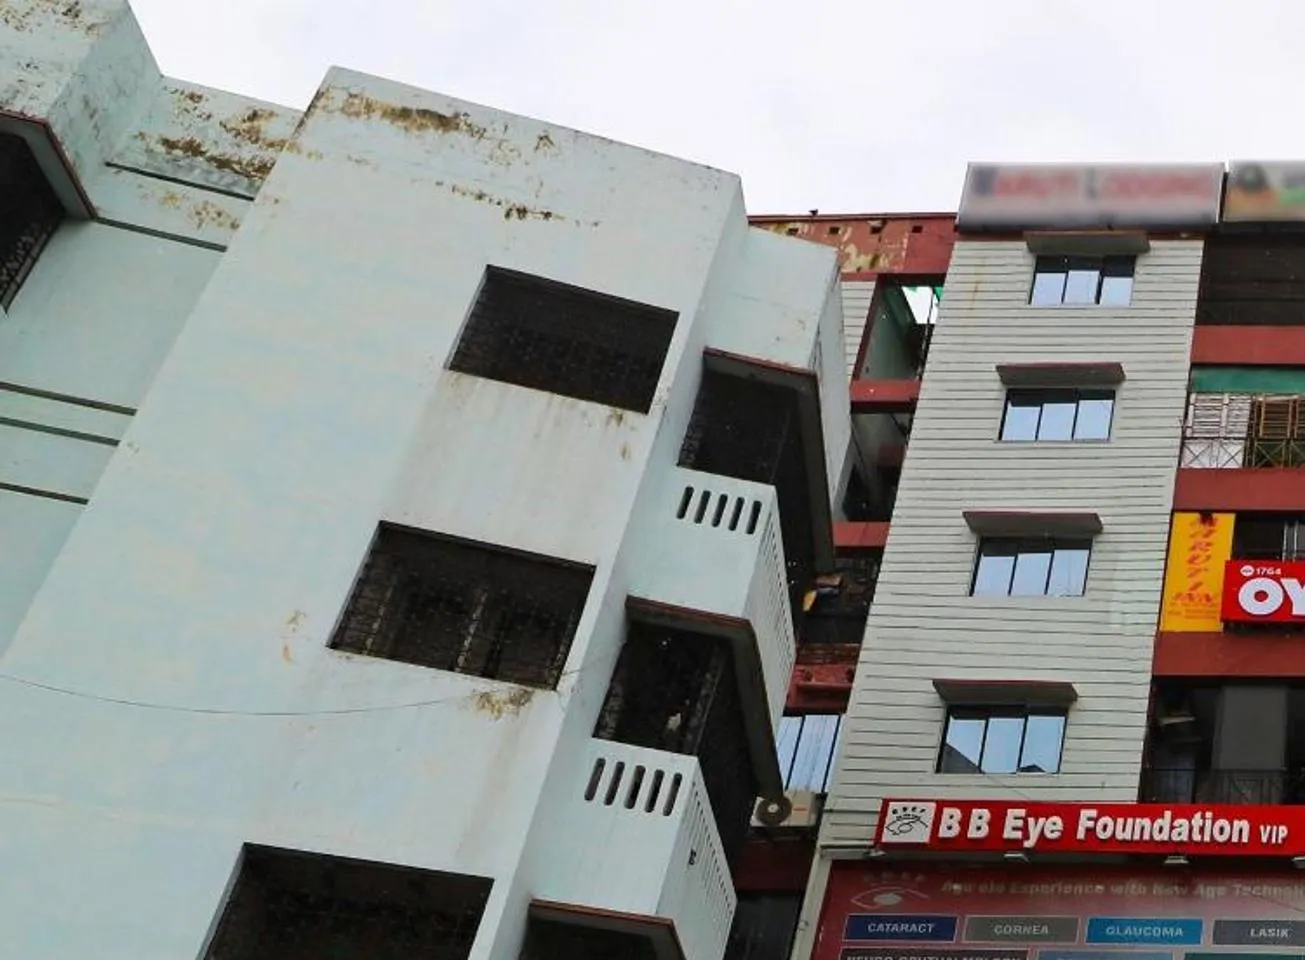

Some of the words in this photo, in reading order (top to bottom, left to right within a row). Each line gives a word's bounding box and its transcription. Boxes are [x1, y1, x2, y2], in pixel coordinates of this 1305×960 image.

[1256, 567, 1281, 575] 1764
[938, 807, 962, 839] B
[967, 807, 992, 839] B
[1003, 808, 1064, 848] Eye
[1077, 809, 1250, 843] Foundation
[1260, 825, 1289, 844] VIP
[868, 922, 937, 934] CATARACT
[994, 925, 1050, 936] CORNEA
[1106, 926, 1184, 937] GLAUCOMA
[1250, 928, 1290, 938] LASIK
